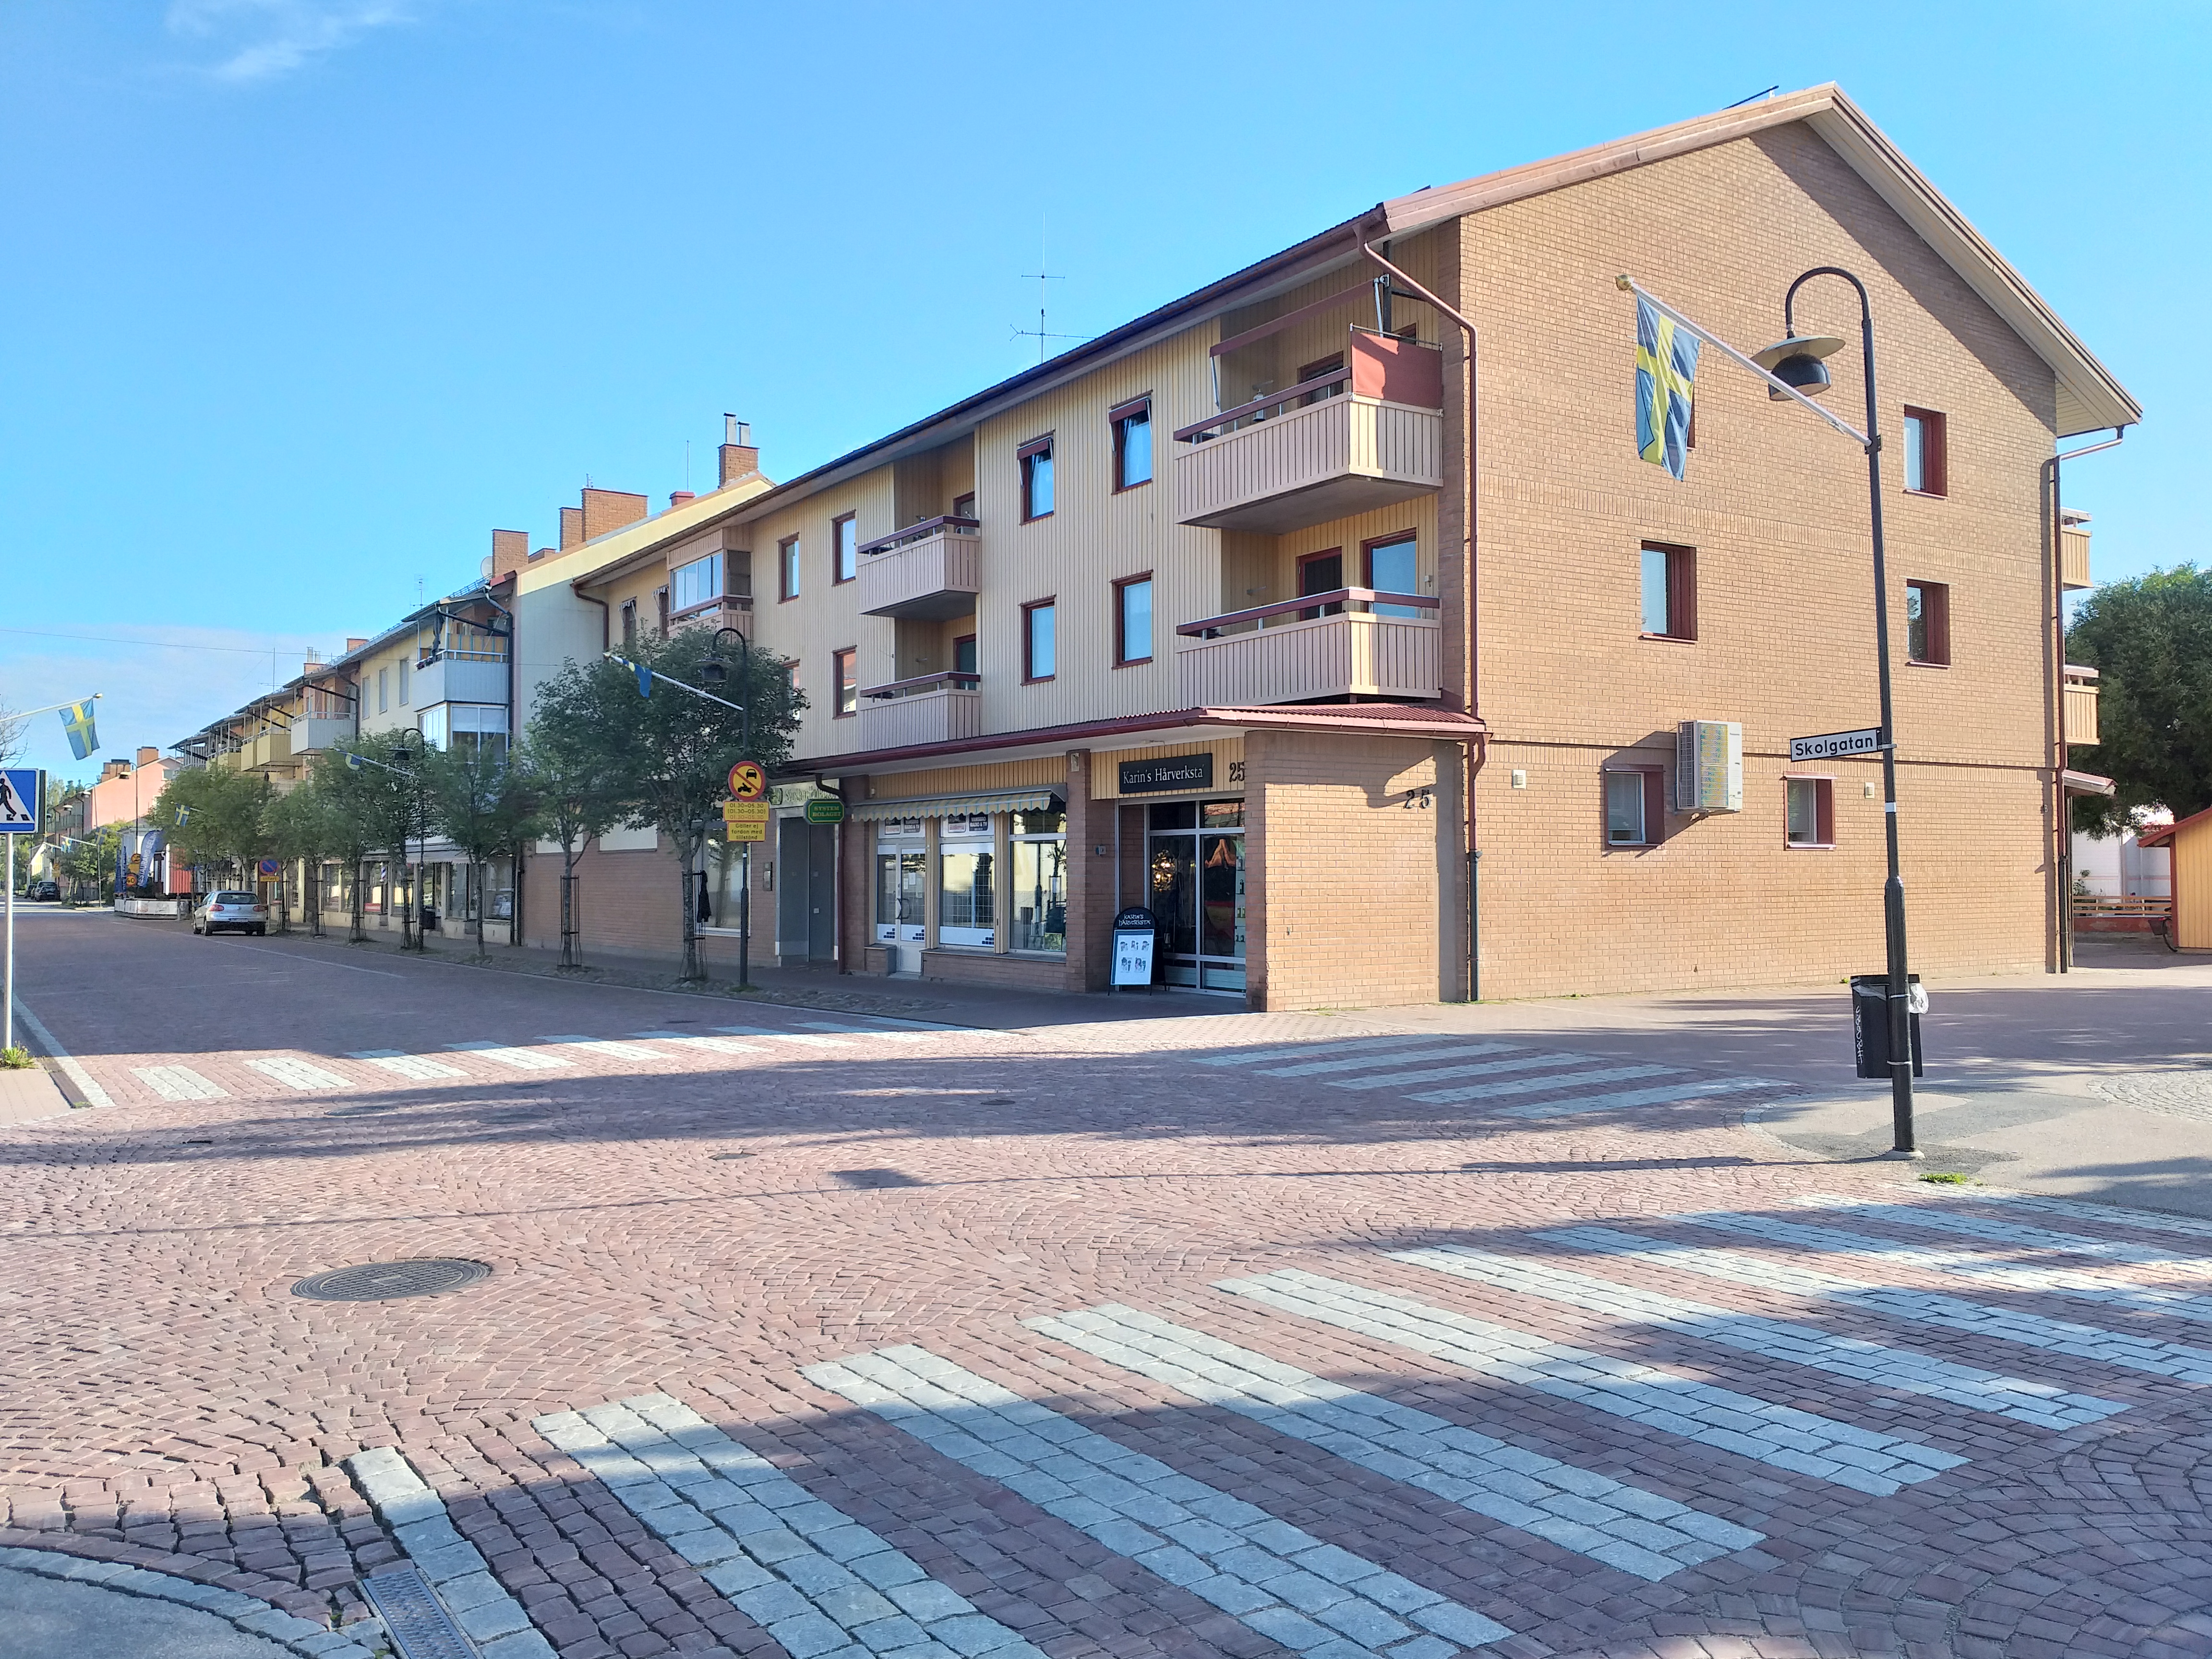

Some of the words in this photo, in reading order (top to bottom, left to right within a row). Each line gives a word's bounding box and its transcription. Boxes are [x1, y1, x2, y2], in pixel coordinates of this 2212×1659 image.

[1795, 737, 1873, 756] Skolgatan
[1123, 769, 1152, 784] Karin's
[1229, 762, 1244, 782] 25
[1404, 789, 1430, 809] 25
